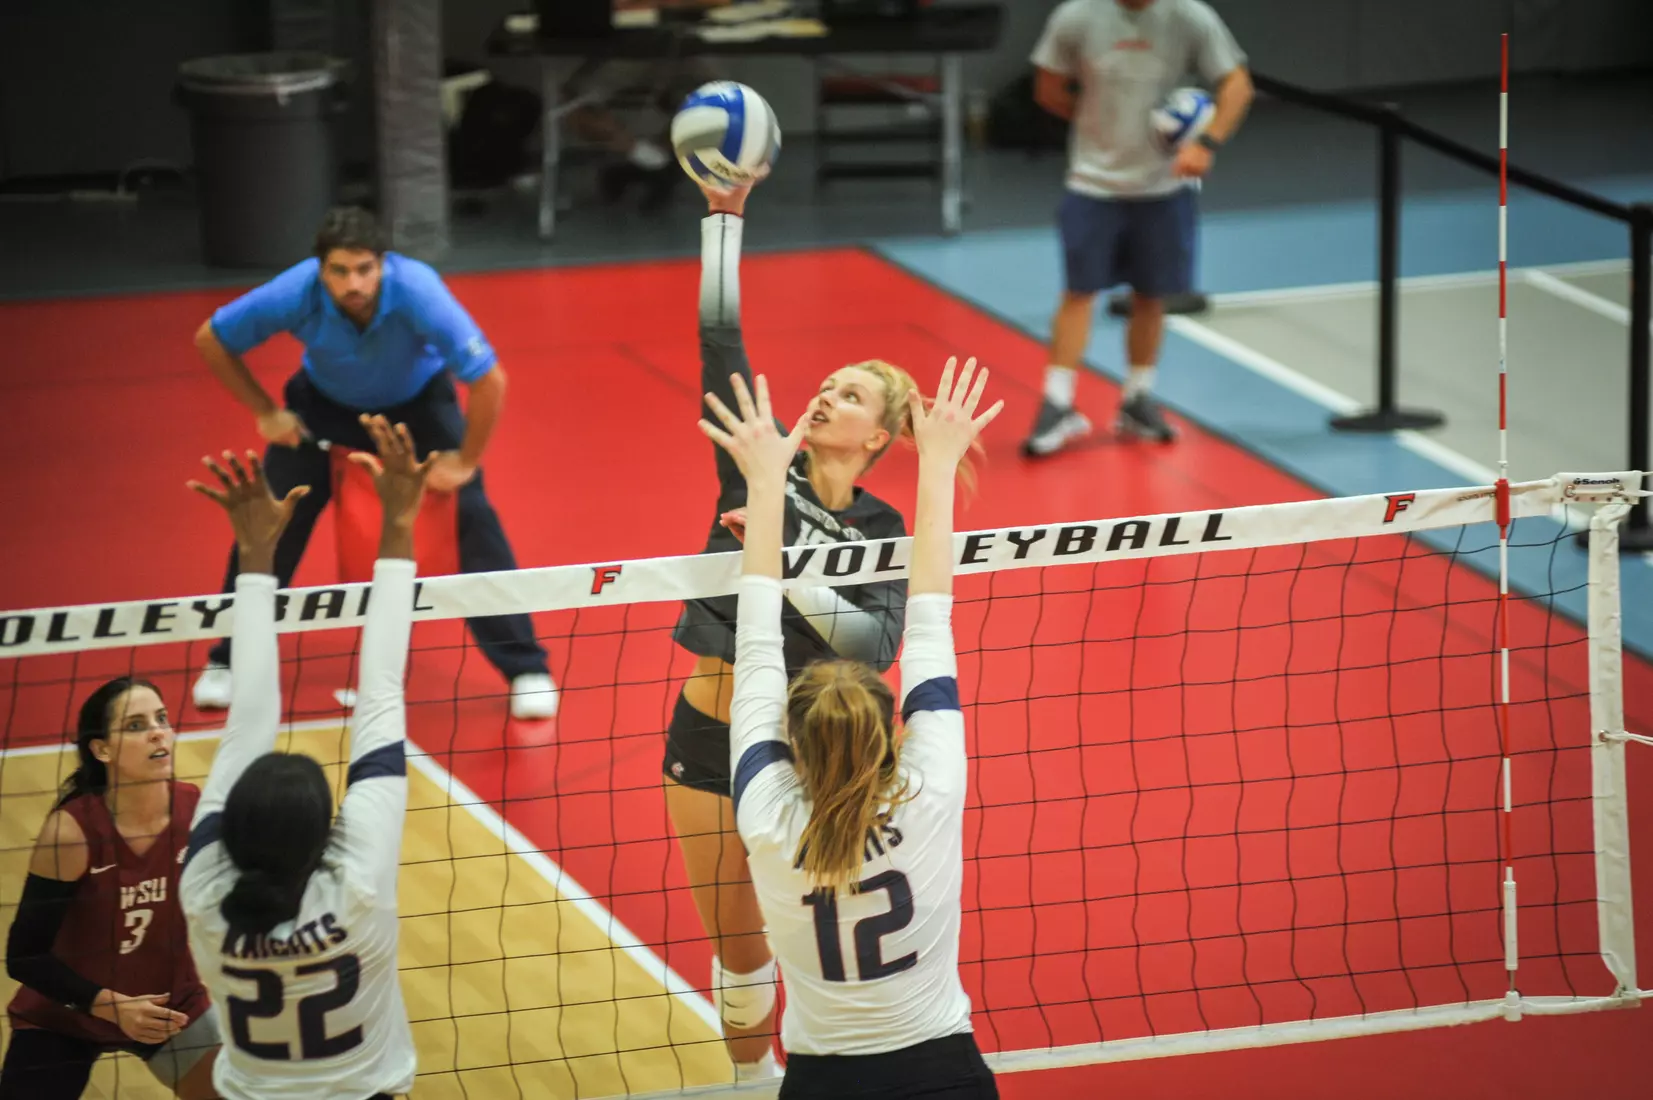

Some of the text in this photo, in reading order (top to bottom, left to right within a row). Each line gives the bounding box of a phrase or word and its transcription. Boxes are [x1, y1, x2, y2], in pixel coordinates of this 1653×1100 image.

[1383, 493, 1416, 524] F
[782, 512, 1231, 579] VOLEYBALL
[590, 564, 623, 595] F
[119, 876, 168, 910] WSU
[118, 909, 155, 955] 3
[801, 869, 918, 982] 12
[222, 952, 365, 1060] 22
